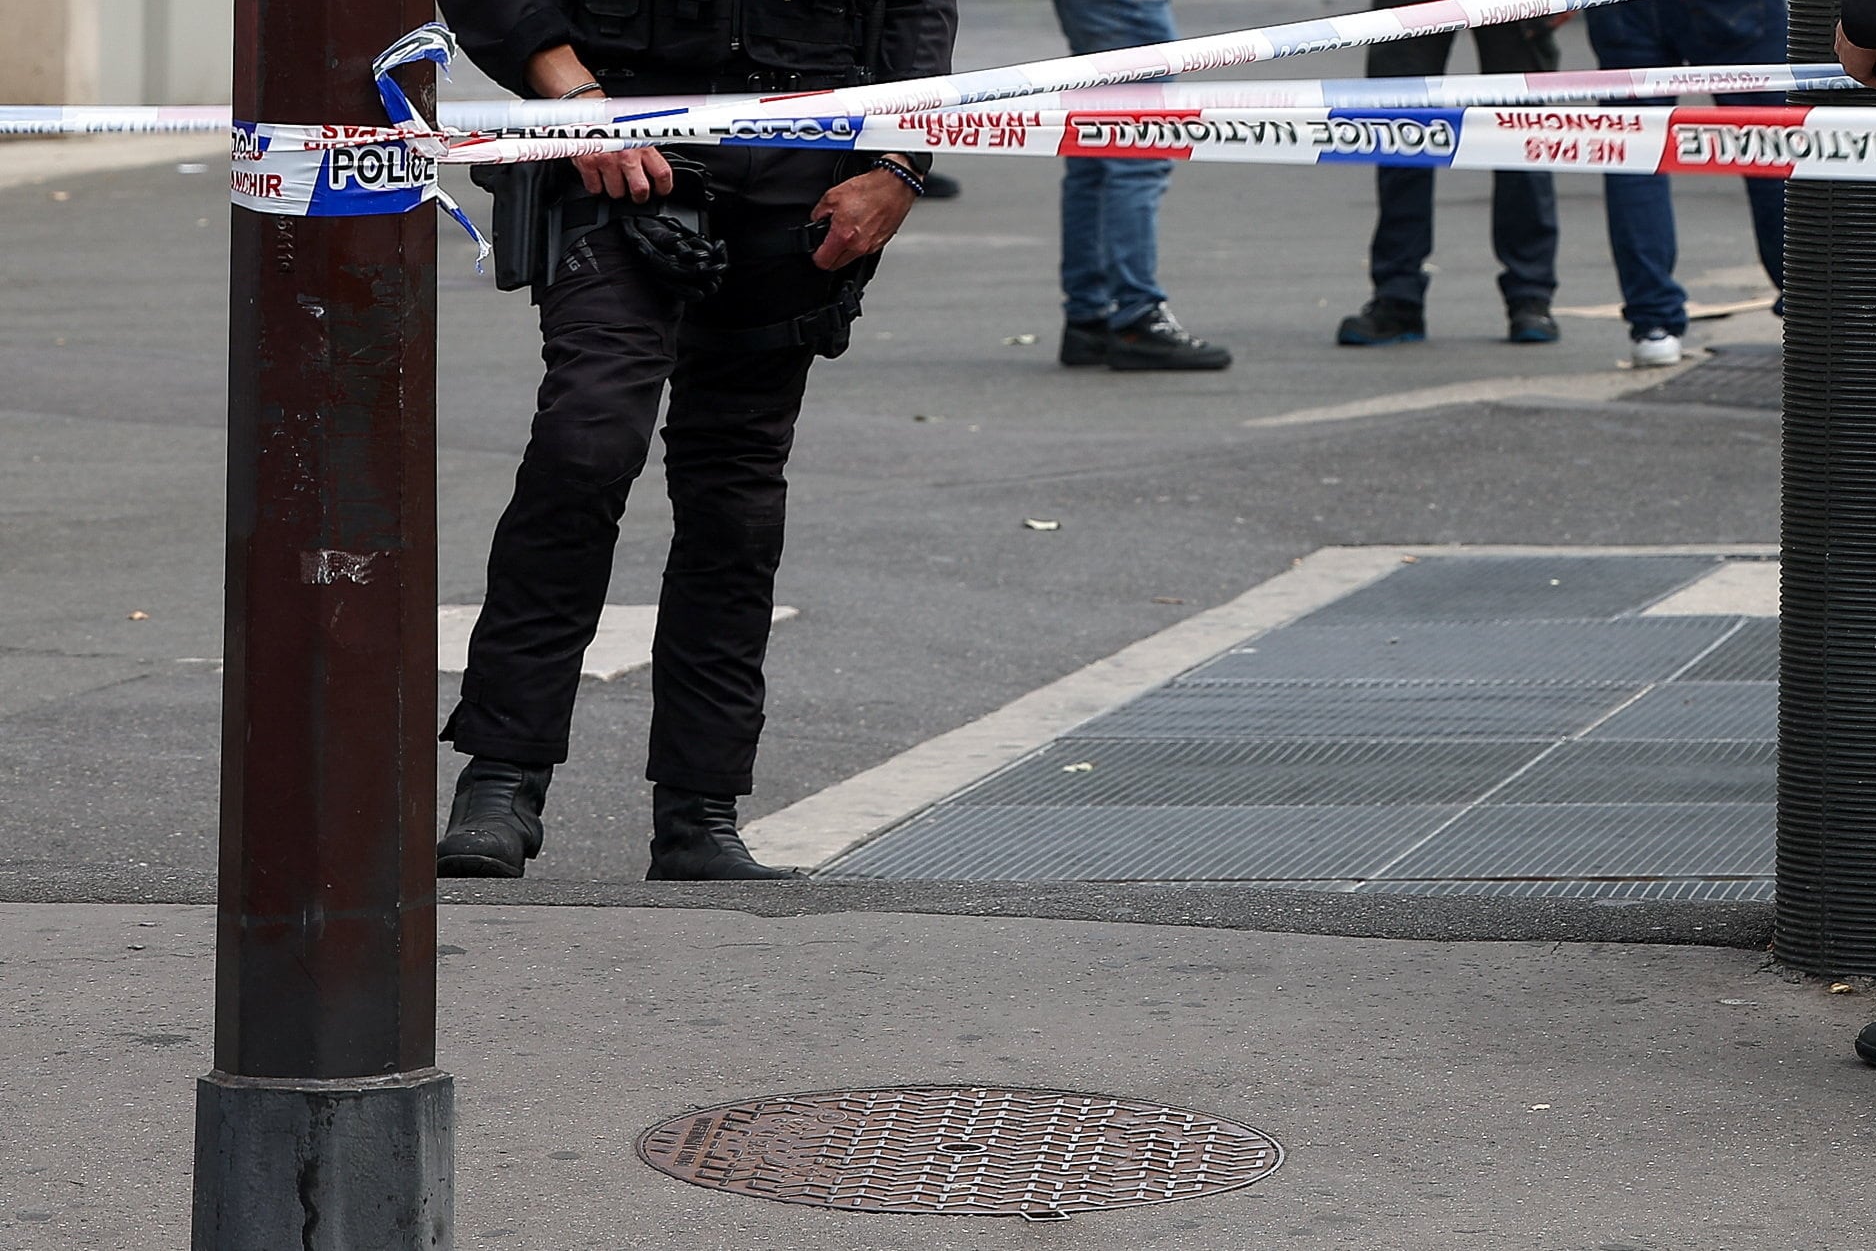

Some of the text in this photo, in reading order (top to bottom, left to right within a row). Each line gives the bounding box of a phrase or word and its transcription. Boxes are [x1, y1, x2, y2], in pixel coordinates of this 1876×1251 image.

[899, 112, 1042, 129] FRANCHIR
[1495, 112, 1643, 132] FRANCHIR
[926, 128, 1027, 147] NE PAS
[1073, 119, 1450, 149] POLICE NATIONALE
[1524, 136, 1626, 164] NE PAS
[332, 149, 435, 184] POLICE
